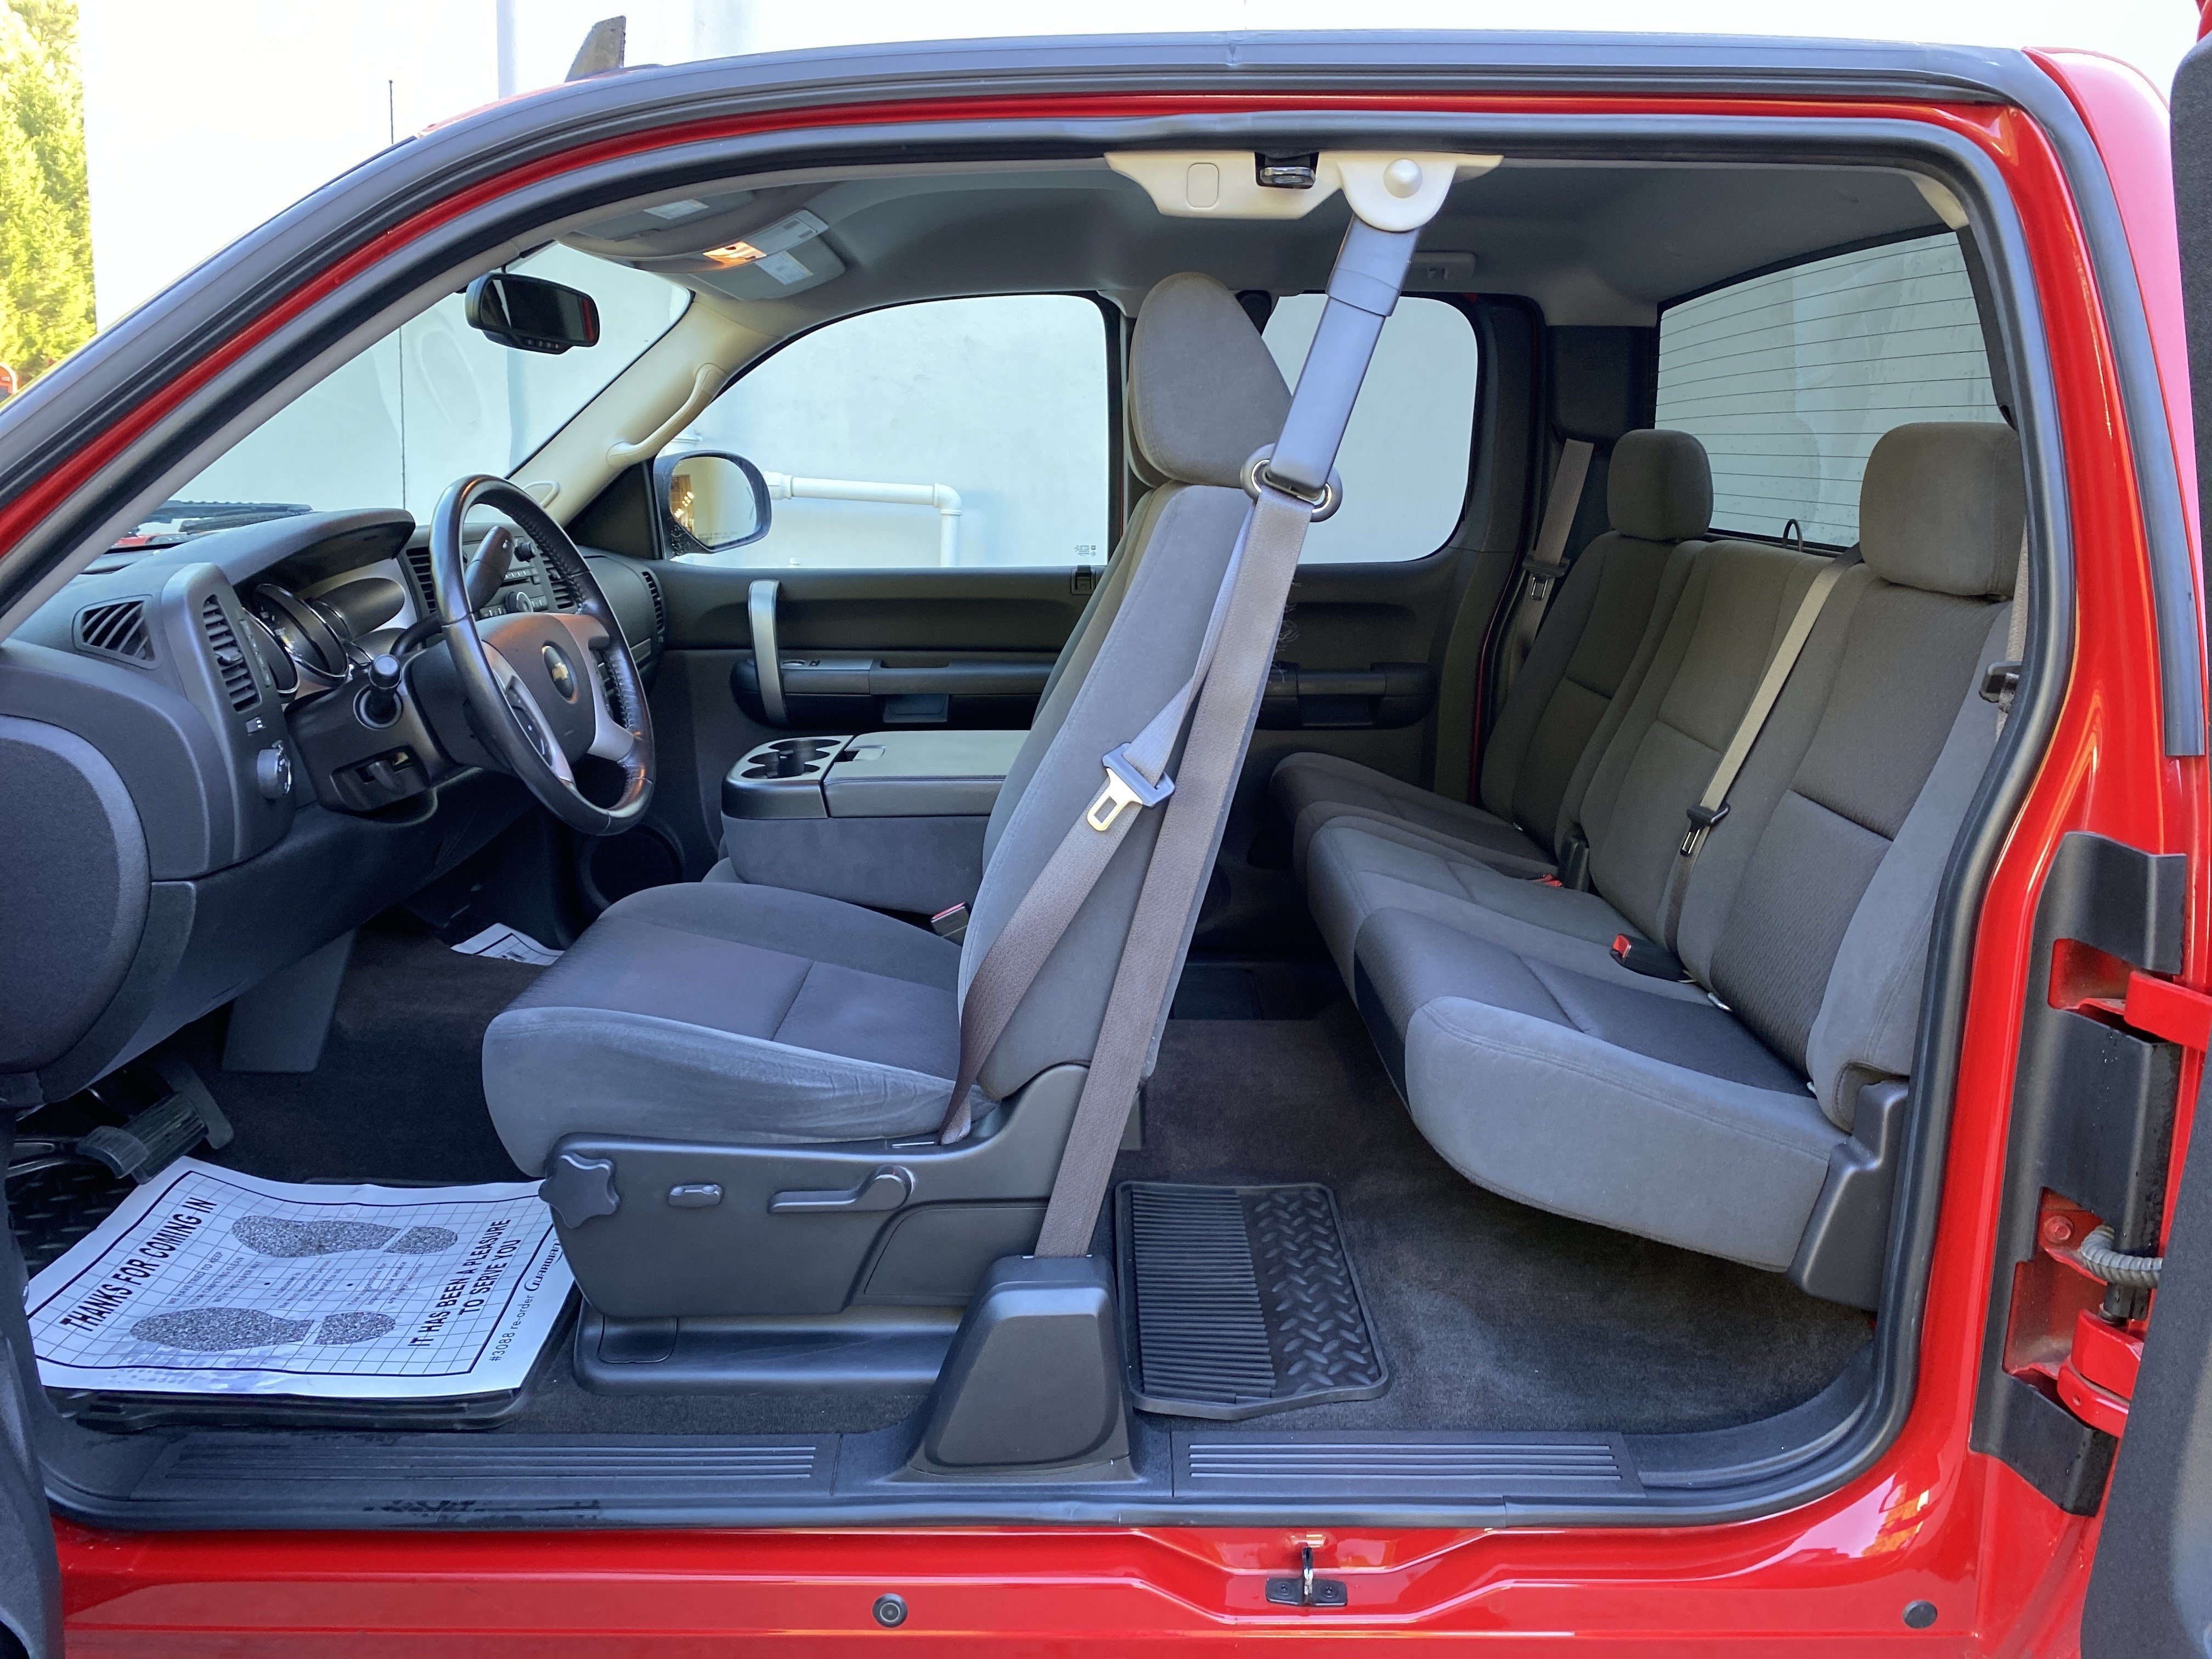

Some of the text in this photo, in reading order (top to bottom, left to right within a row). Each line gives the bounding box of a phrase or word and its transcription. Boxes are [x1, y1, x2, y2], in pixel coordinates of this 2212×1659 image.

[59, 1197, 217, 1331] THANKS FOR COMING IN
[226, 1257, 245, 1271] CLEAN
[462, 1220, 511, 1266] PLEASURE
[176, 1285, 193, 1296] HAVE
[188, 1271, 206, 1285] TRIED
[210, 1251, 223, 1263] KEEP
[435, 1278, 470, 1308] BEEN
[458, 1239, 521, 1316] TO SERVE YOU
[407, 1338, 434, 1346] IT
[417, 1311, 450, 1333] HAS
[488, 1333, 515, 1361] #3088
[510, 1295, 534, 1329] re-order
